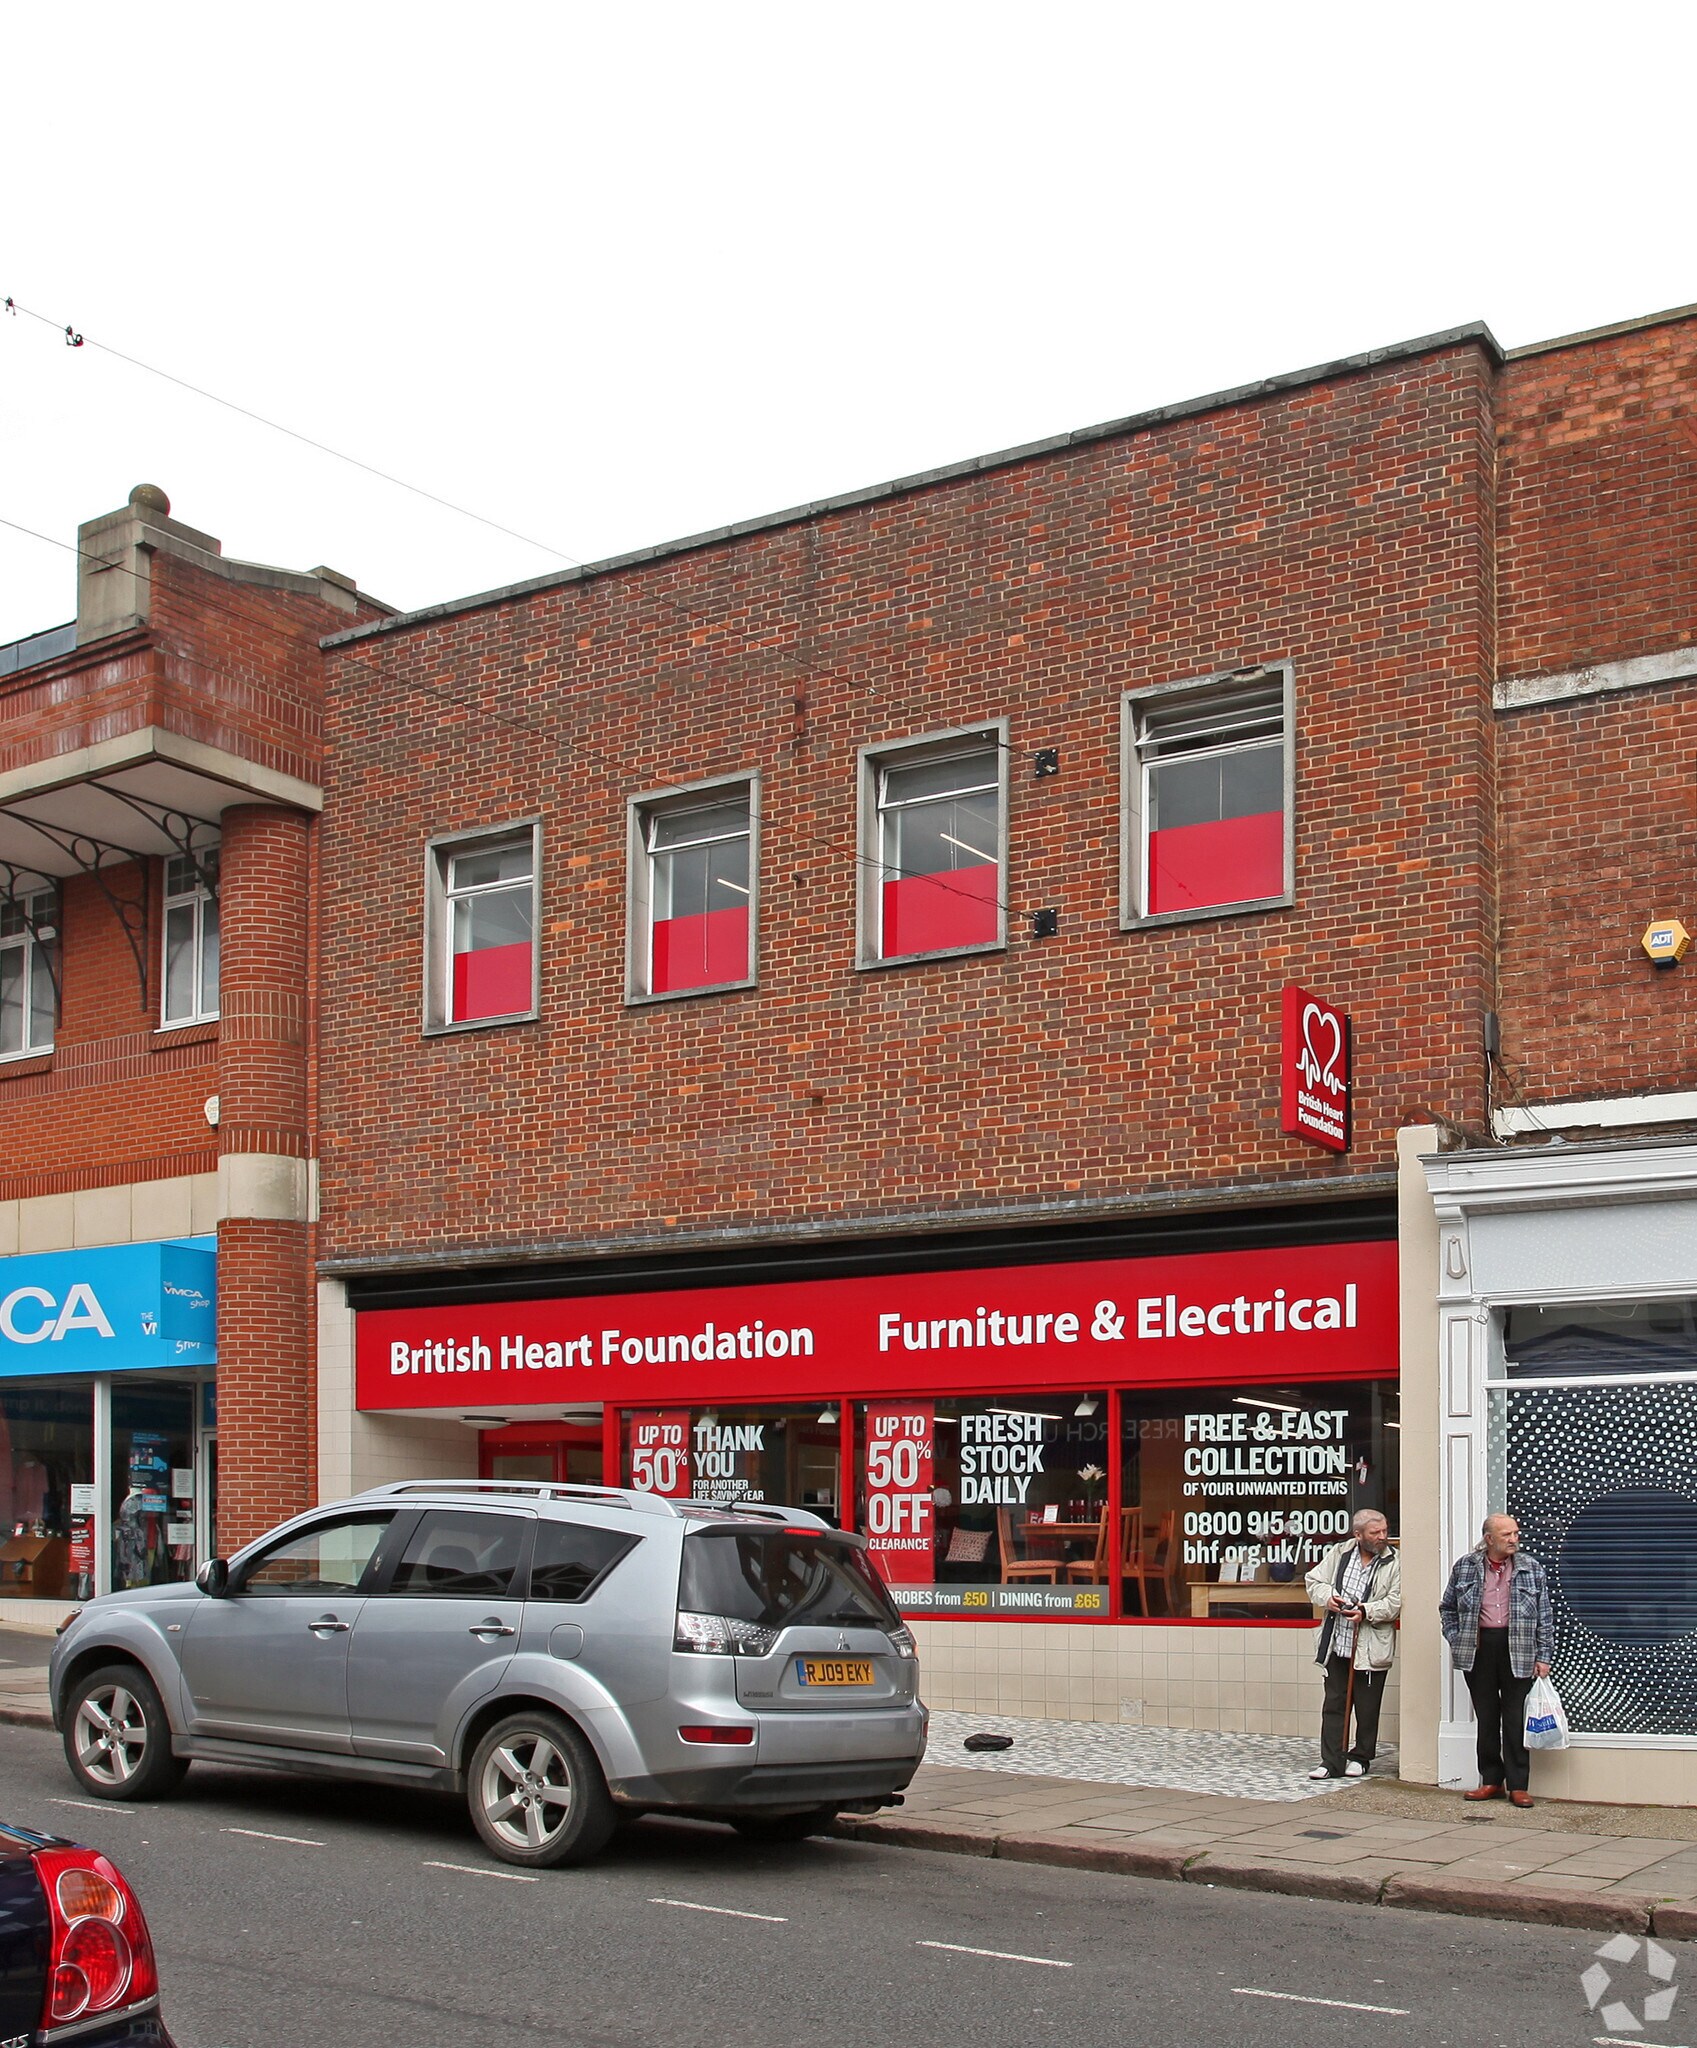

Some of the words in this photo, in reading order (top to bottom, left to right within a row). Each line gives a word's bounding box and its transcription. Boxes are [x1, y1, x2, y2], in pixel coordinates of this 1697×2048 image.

[1651, 933, 1673, 946] ADT
[1298, 1090, 1322, 1113] British
[1323, 1101, 1343, 1122] Heart
[1298, 1106, 1343, 1140] Foundation
[0, 1283, 116, 1344] CA
[141, 1311, 154, 1320] THE
[878, 1306, 1080, 1352] Furniture
[1090, 1299, 1125, 1341] &
[1137, 1283, 1358, 1339] Electrical
[390, 1336, 491, 1376] British
[500, 1333, 593, 1371] Heart
[601, 1320, 815, 1366] Foundation
[638, 1425, 659, 1446] UP
[659, 1424, 682, 1445] TO
[693, 1425, 764, 1452] THANK
[875, 1416, 900, 1438] UP
[901, 1415, 925, 1436] TO
[961, 1414, 1042, 1443] FRESH
[1184, 1412, 1248, 1443] FREE
[1253, 1412, 1278, 1441] &
[1281, 1410, 1349, 1440] FAST
[632, 1448, 688, 1492] 50%
[693, 1451, 735, 1478] YOU
[868, 1439, 932, 1488] 50%
[960, 1445, 1045, 1474] STOCK
[1184, 1445, 1346, 1477] COLLECTION
[693, 1480, 709, 1490] FOR
[710, 1479, 749, 1490] ANOTHER
[693, 1490, 709, 1500] LIFE
[742, 1490, 764, 1501] YEAR
[961, 1475, 1032, 1504] DAILY
[1183, 1482, 1199, 1496] OF
[1200, 1482, 1237, 1496] YOUR
[1238, 1481, 1306, 1496] UNWANTED
[1308, 1481, 1348, 1495] ITEMS
[868, 1493, 932, 1534] OFF
[1184, 1511, 1242, 1536] 0800
[1247, 1511, 1285, 1536] 915
[1289, 1510, 1349, 1535] 3000
[869, 1537, 931, 1551] CLEARANCE
[935, 1591, 961, 1606] from
[963, 1591, 988, 1606] £50
[1000, 1592, 1042, 1608] DINING
[1044, 1593, 1072, 1608] from
[1074, 1593, 1101, 1609] £65
[806, 1664, 844, 1682] RJ09
[847, 1664, 870, 1682] EKY
